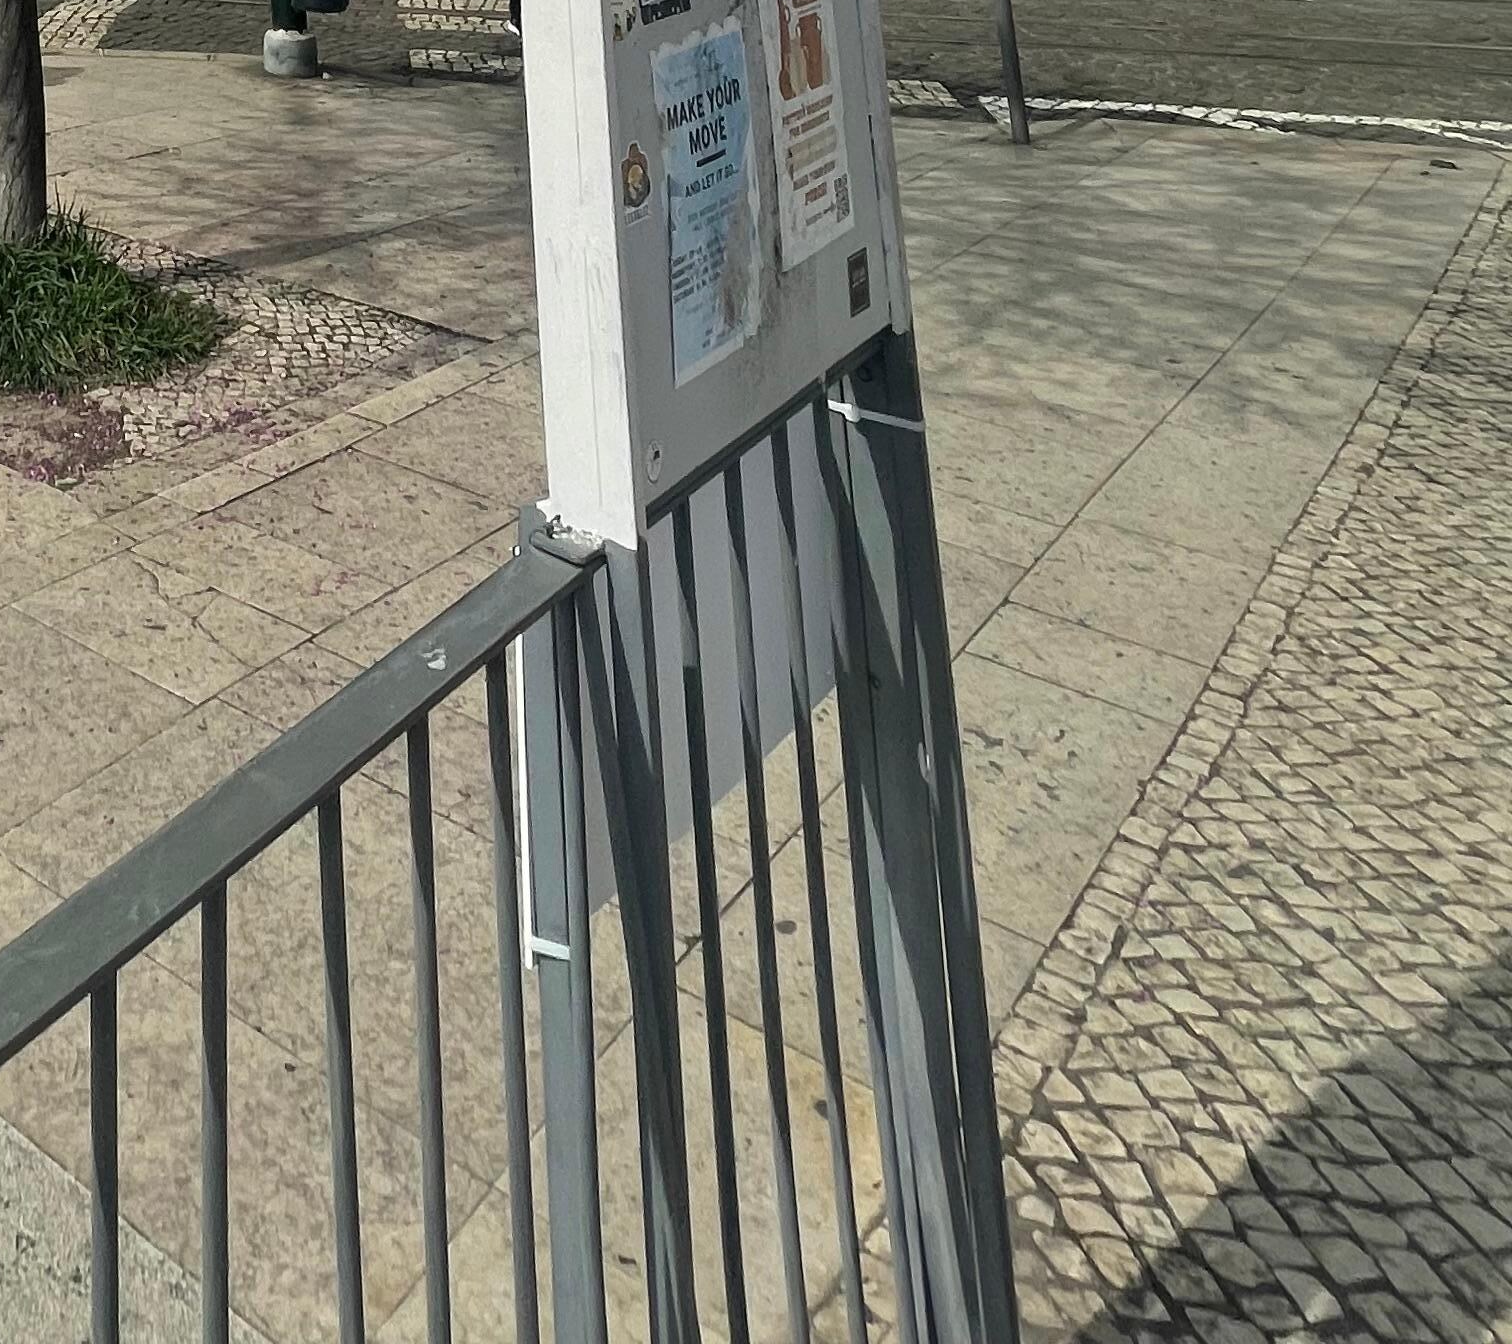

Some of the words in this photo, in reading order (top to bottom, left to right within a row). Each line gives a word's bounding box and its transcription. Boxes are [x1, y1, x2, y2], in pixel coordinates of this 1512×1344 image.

[666, 93, 705, 131] MAKE
[706, 78, 741, 113] YOUR
[689, 117, 728, 155] MOVE
[701, 173, 715, 190] LET
